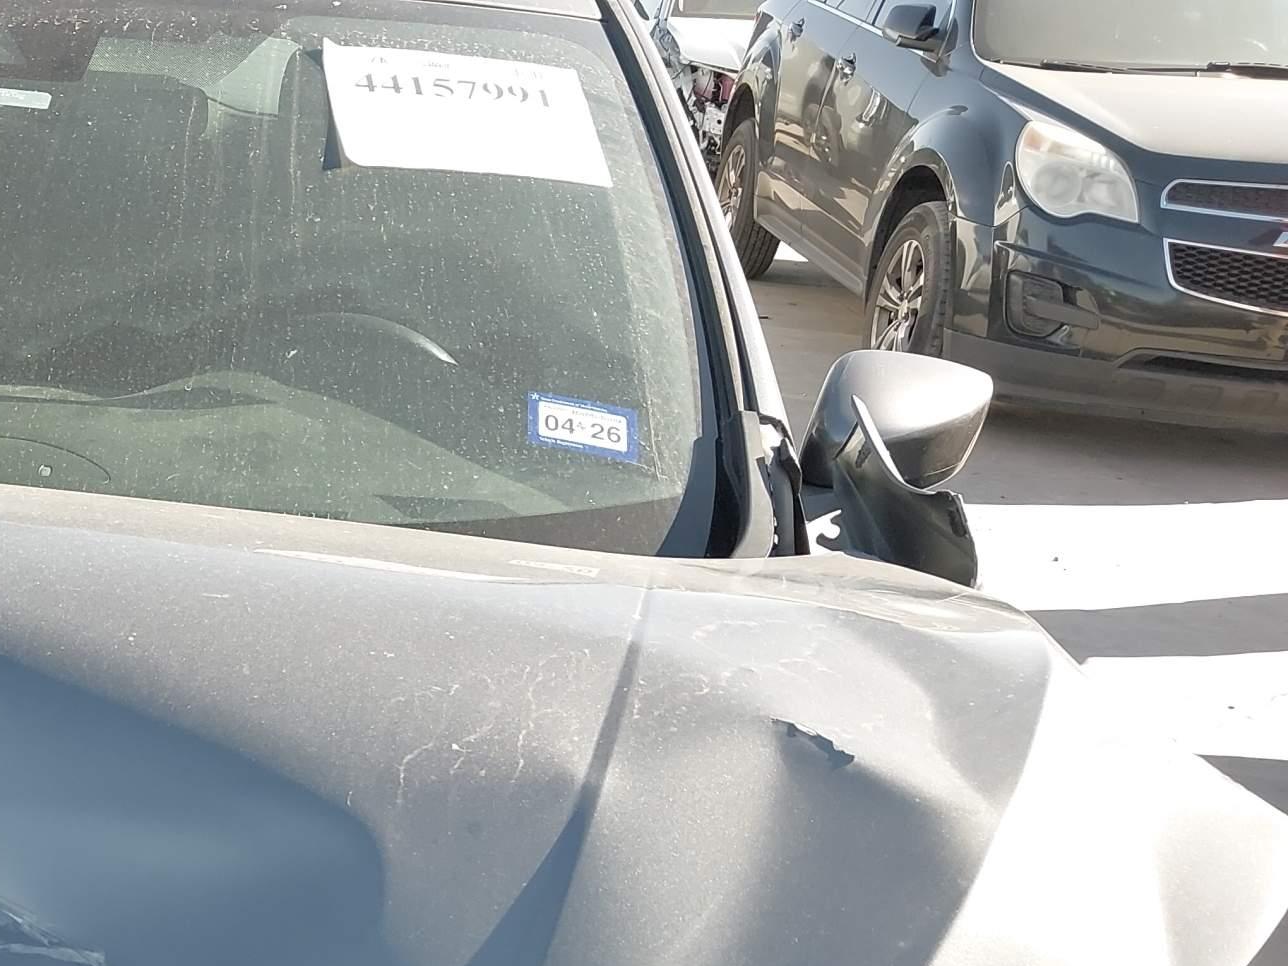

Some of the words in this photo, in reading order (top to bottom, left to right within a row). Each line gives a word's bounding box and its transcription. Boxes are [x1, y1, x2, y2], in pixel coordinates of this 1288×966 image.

[354, 73, 550, 108] 44157991
[544, 414, 575, 435] 04
[590, 423, 622, 444] 26
